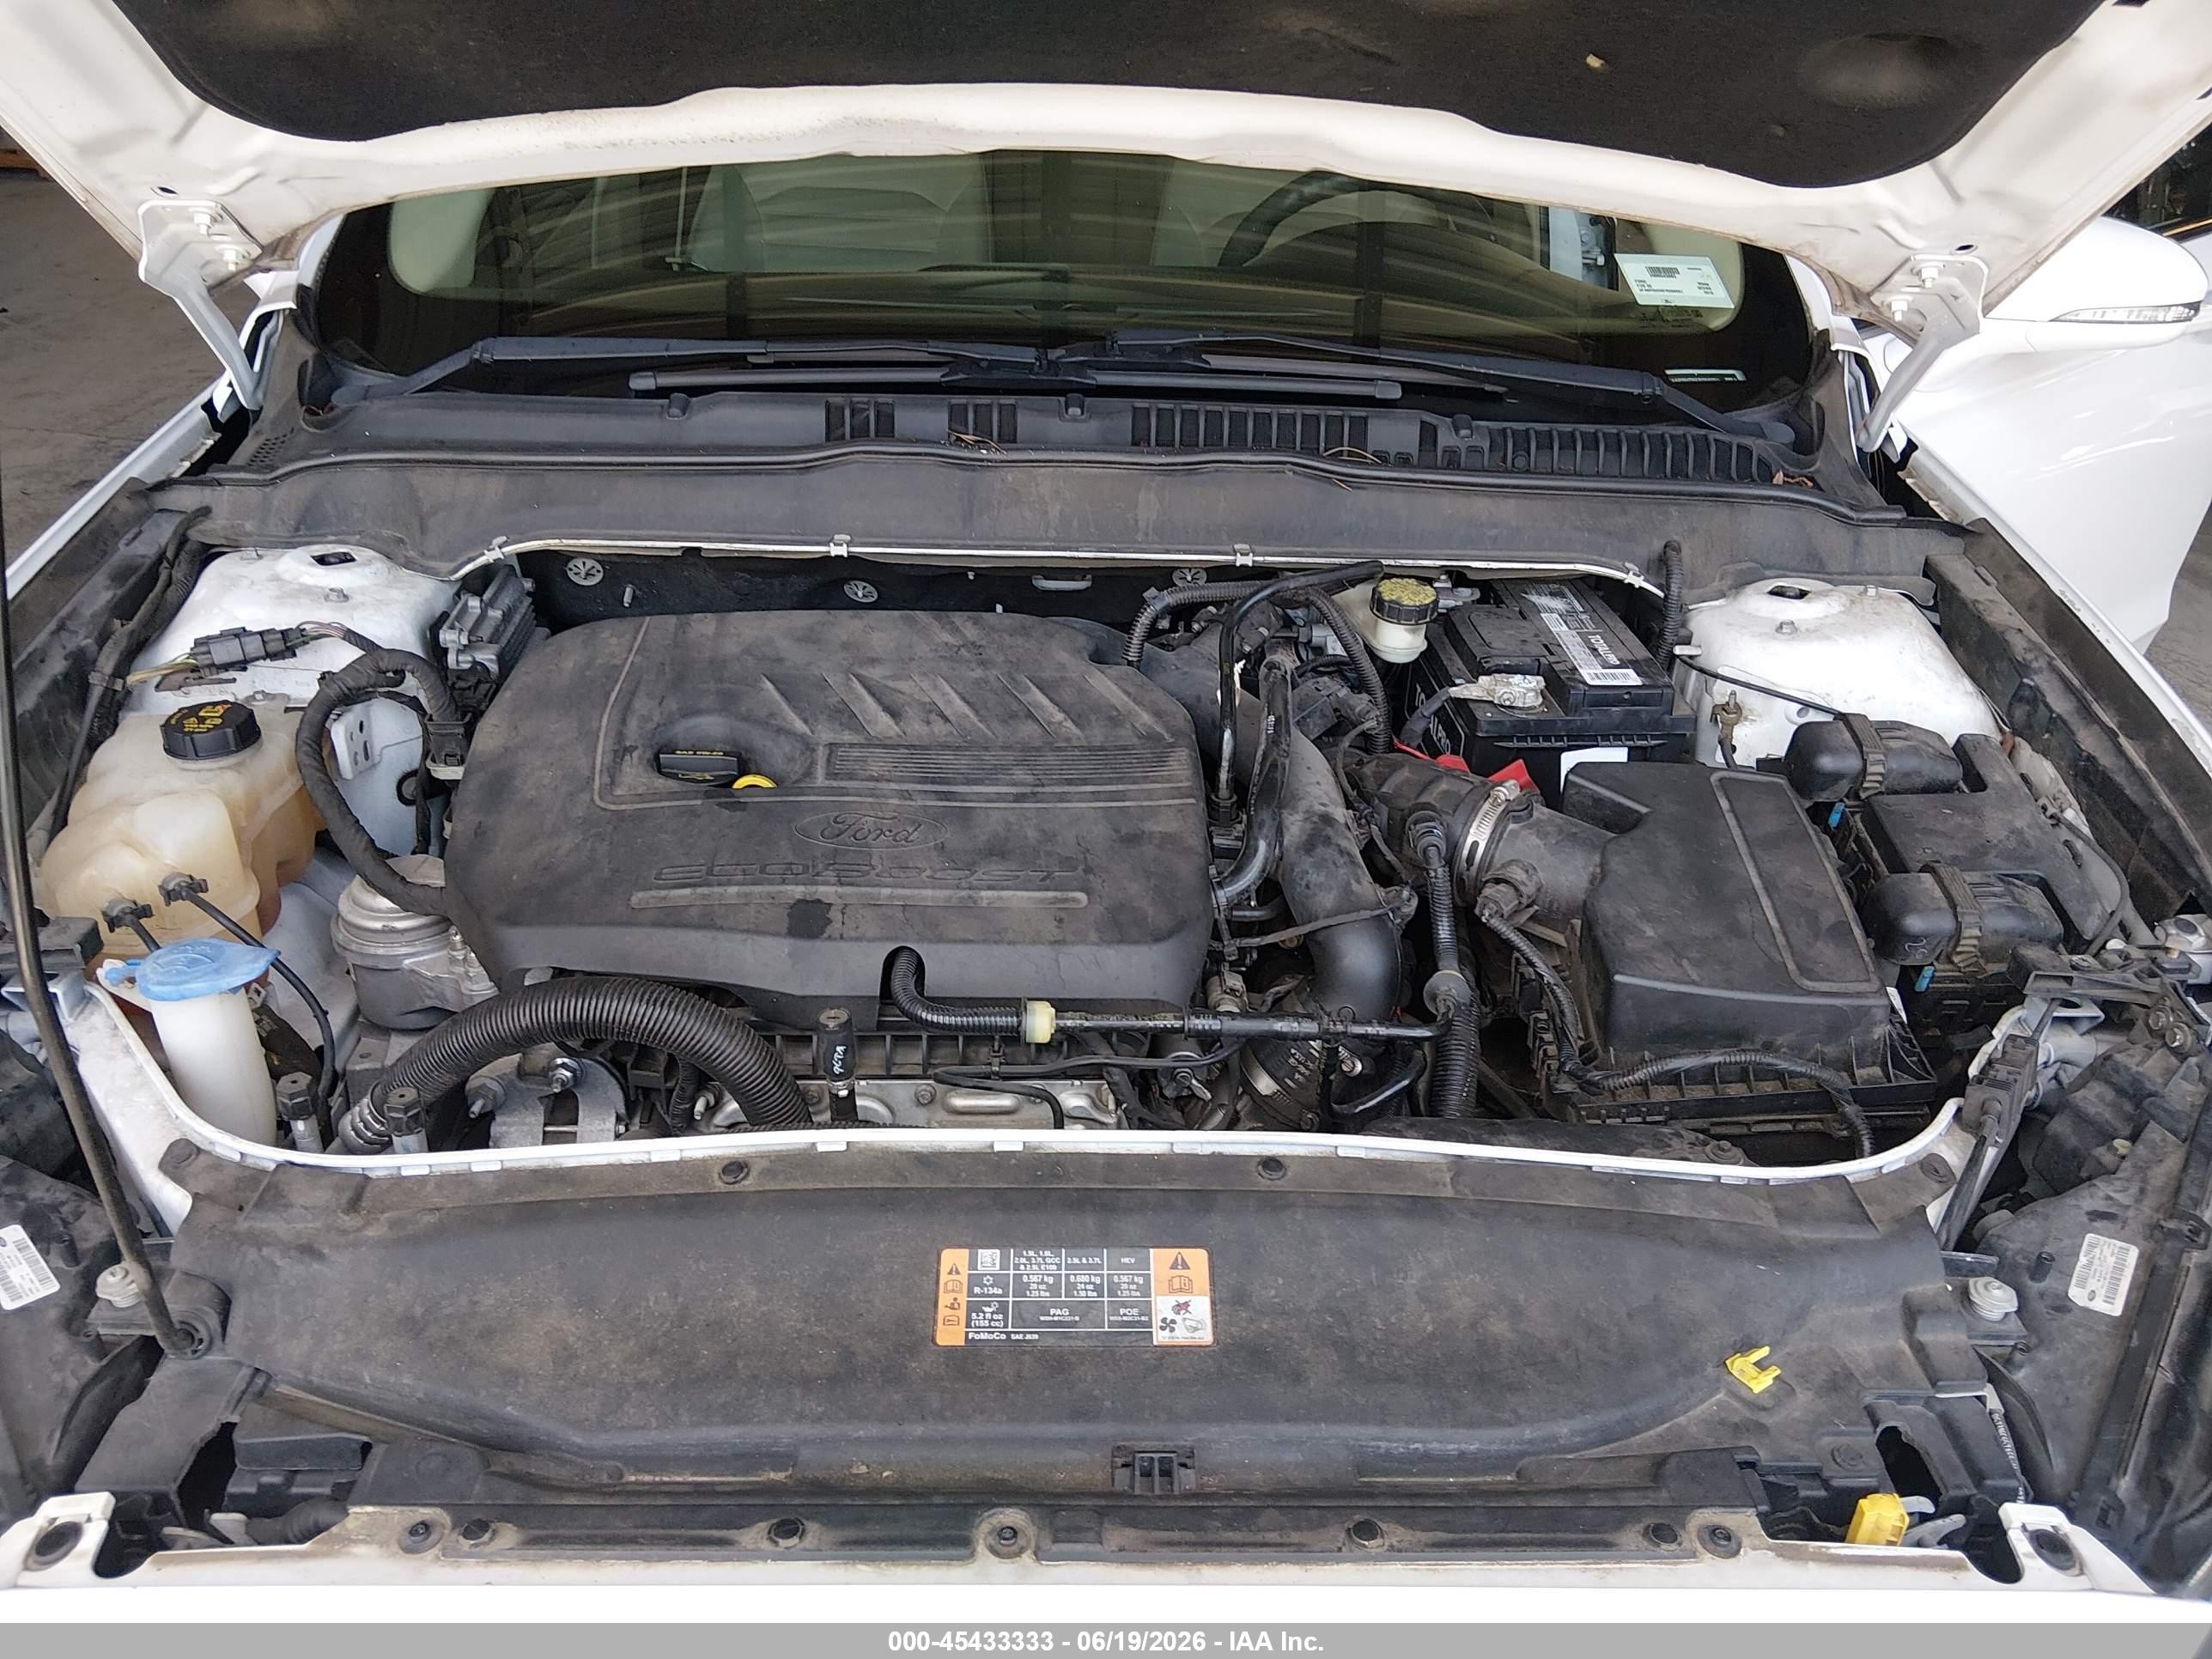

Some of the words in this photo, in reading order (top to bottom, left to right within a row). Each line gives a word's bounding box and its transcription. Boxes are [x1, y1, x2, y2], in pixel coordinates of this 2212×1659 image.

[1588, 635, 1620, 665] TOTALPRO
[817, 811, 922, 846] Ford
[1022, 1274, 1042, 1283] 0.567
[1043, 1274, 1054, 1285] kg
[1091, 1274, 1101, 1285] kg
[1113, 1274, 1133, 1283] 0.567
[1133, 1274, 1144, 1285] kg
[974, 1286, 1003, 1295] R-134a
